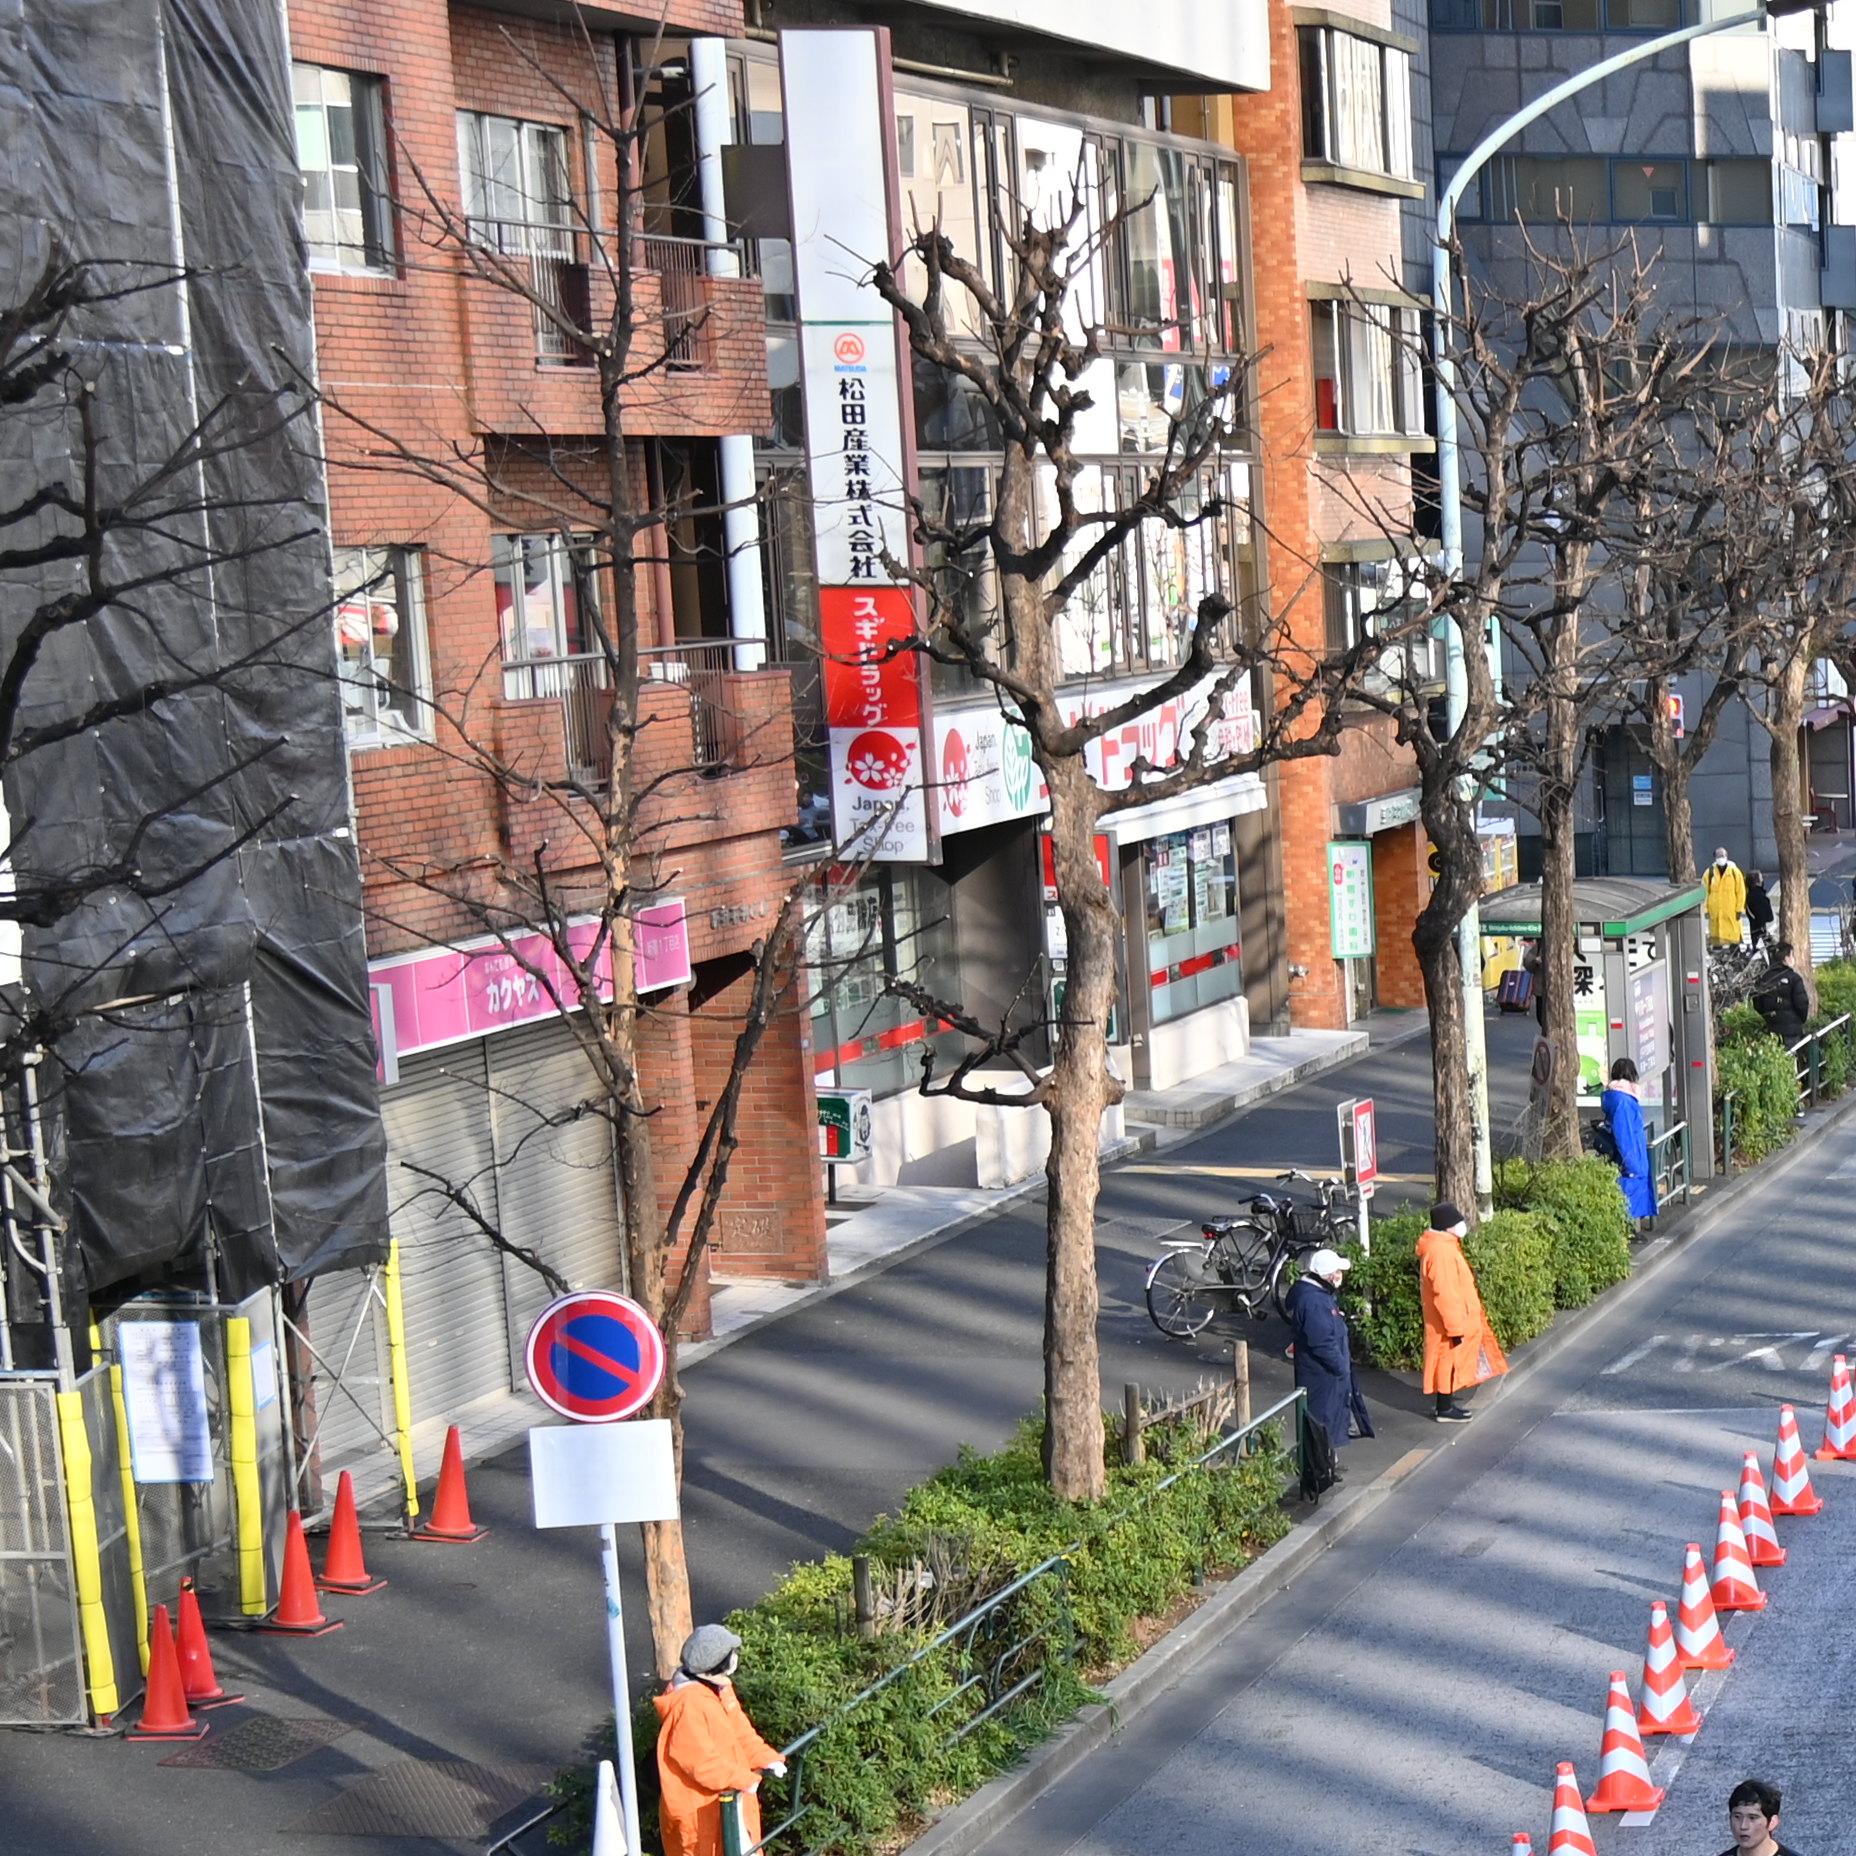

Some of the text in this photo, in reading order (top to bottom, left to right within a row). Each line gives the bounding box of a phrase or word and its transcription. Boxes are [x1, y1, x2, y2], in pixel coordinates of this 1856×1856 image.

[838, 377, 878, 580] 松田産業株式会社
[487, 972, 540, 1014] カクヤス
